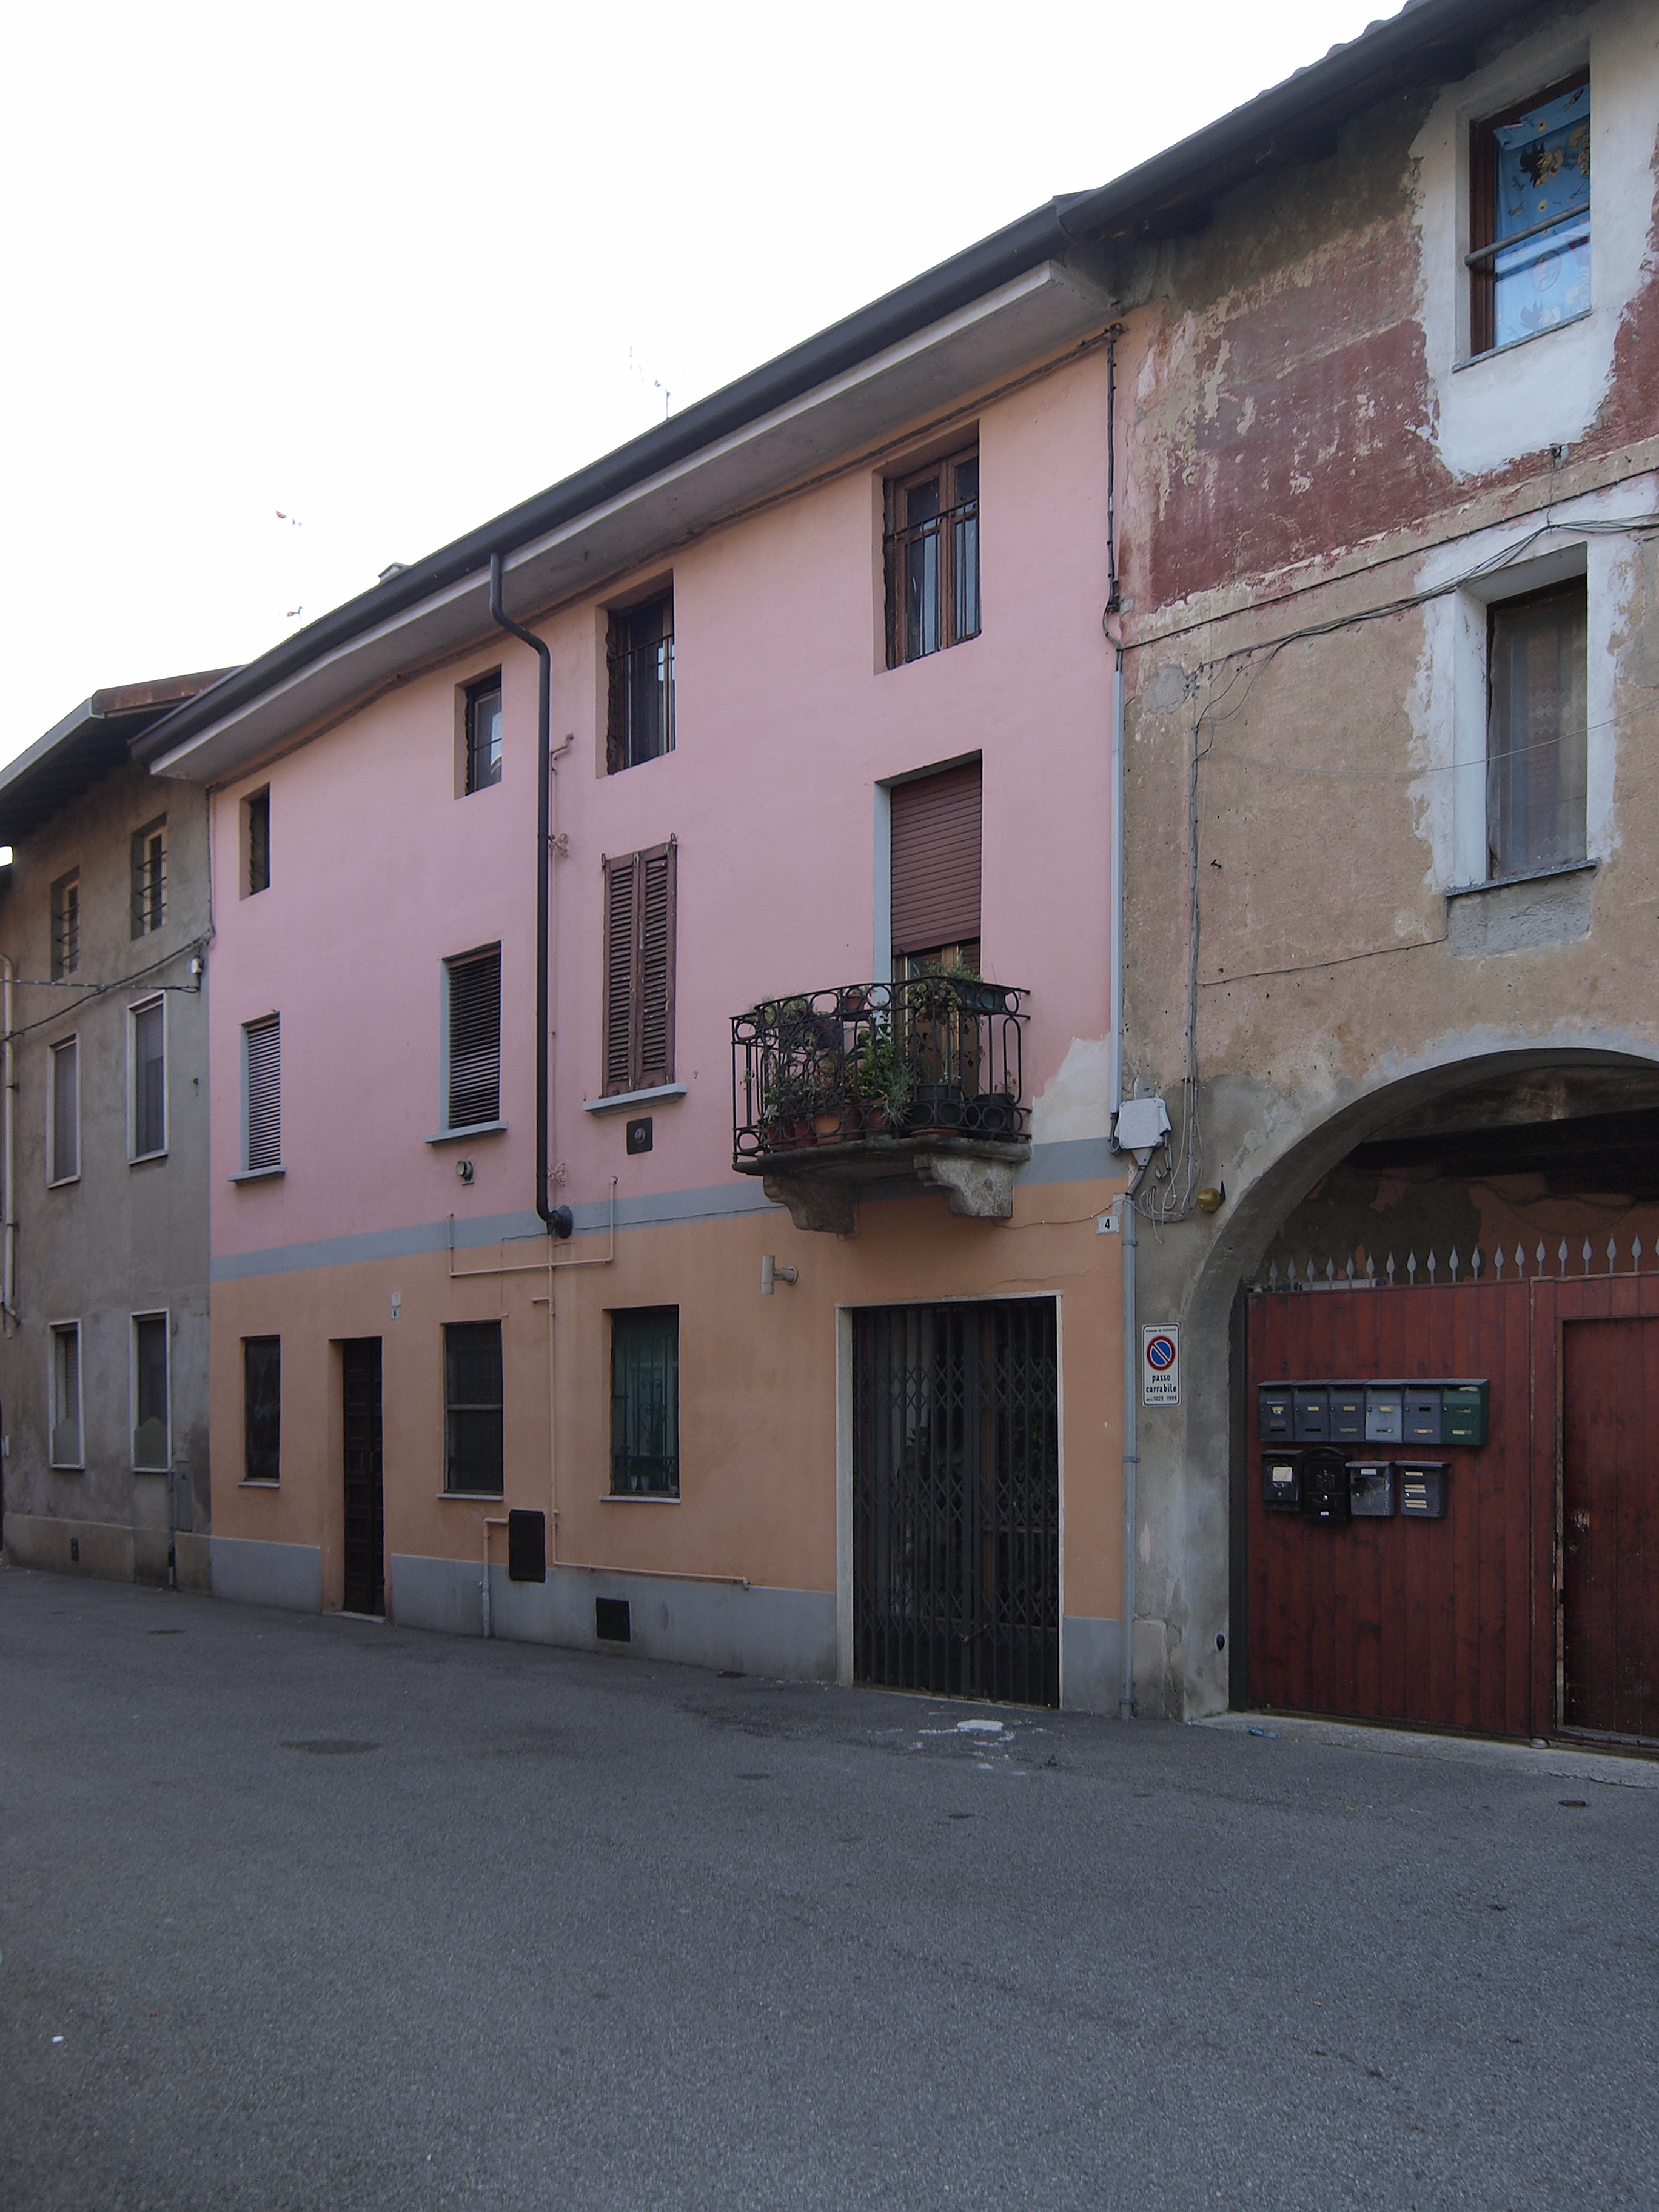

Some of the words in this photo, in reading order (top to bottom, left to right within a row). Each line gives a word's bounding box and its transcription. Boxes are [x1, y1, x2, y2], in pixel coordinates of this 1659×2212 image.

[1105, 1218, 1110, 1229] 4
[1152, 1375, 1171, 1384] passo
[1145, 1384, 1177, 1393] carrabile
